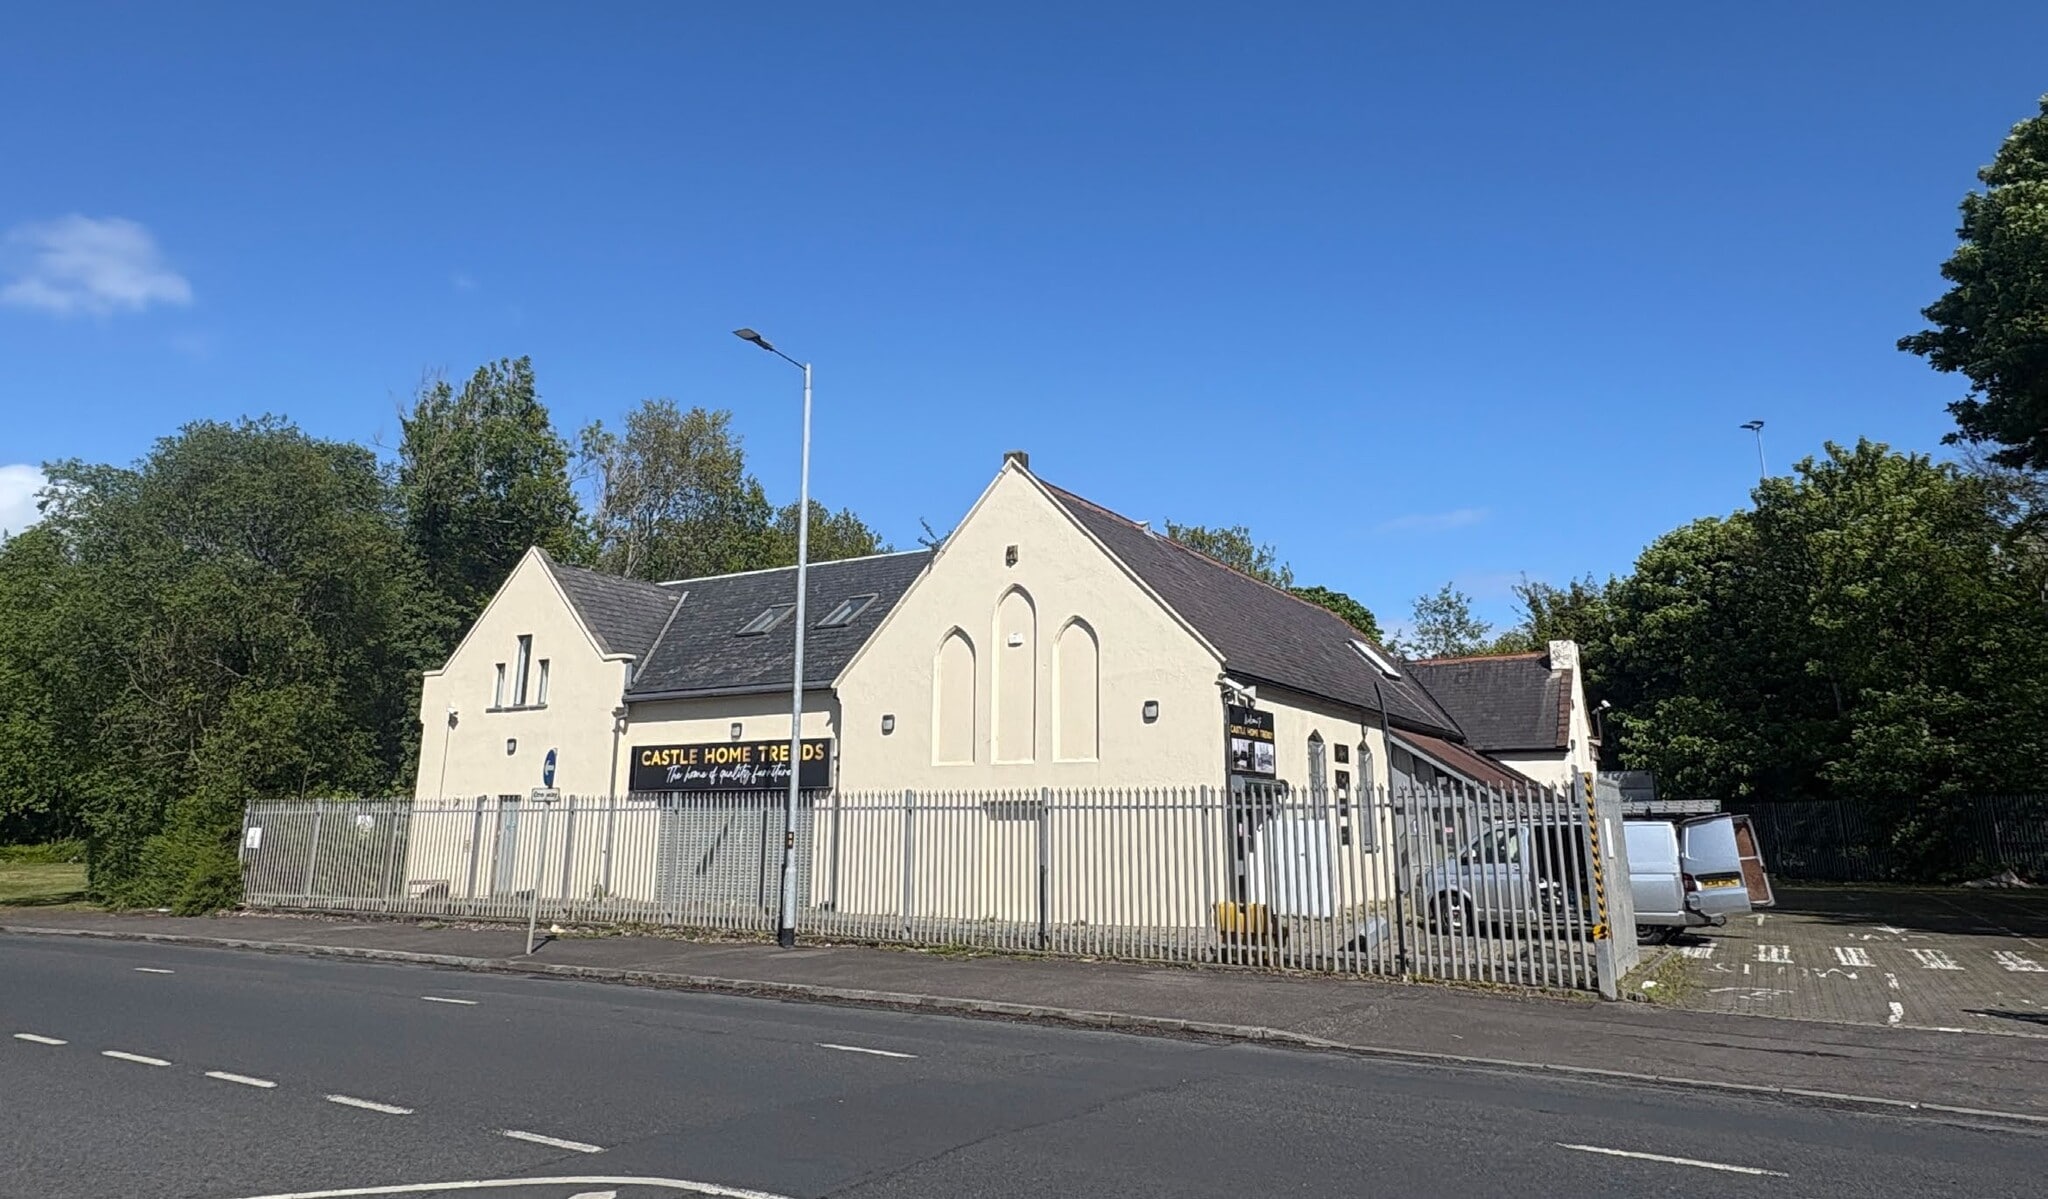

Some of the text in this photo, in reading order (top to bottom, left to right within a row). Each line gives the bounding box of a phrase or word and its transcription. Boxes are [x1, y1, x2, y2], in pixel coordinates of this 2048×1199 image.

[641, 743, 824, 766] CASTLE HOME TREDS
[666, 762, 792, 785] The home of quality furniture
